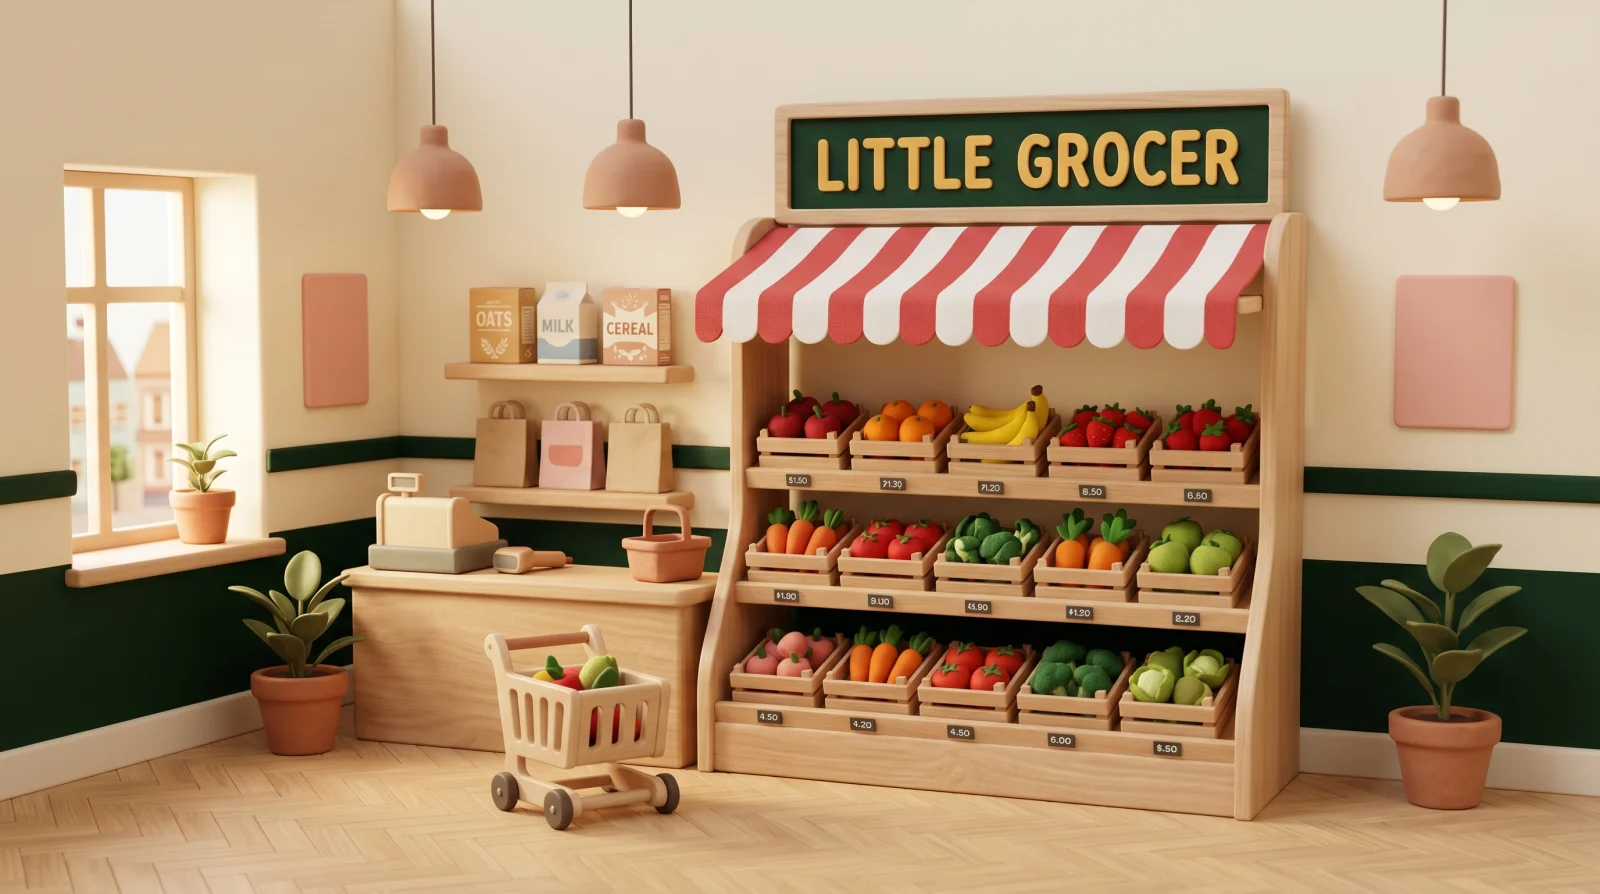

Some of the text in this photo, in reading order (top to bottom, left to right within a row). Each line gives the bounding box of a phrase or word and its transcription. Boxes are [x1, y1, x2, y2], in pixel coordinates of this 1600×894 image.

[817, 128, 1240, 193] LITTLE GROCER
[475, 310, 513, 328] OATS
[541, 319, 574, 333] MILK
[606, 321, 654, 336] CEREAL
[1051, 736, 1071, 744] 6.00
